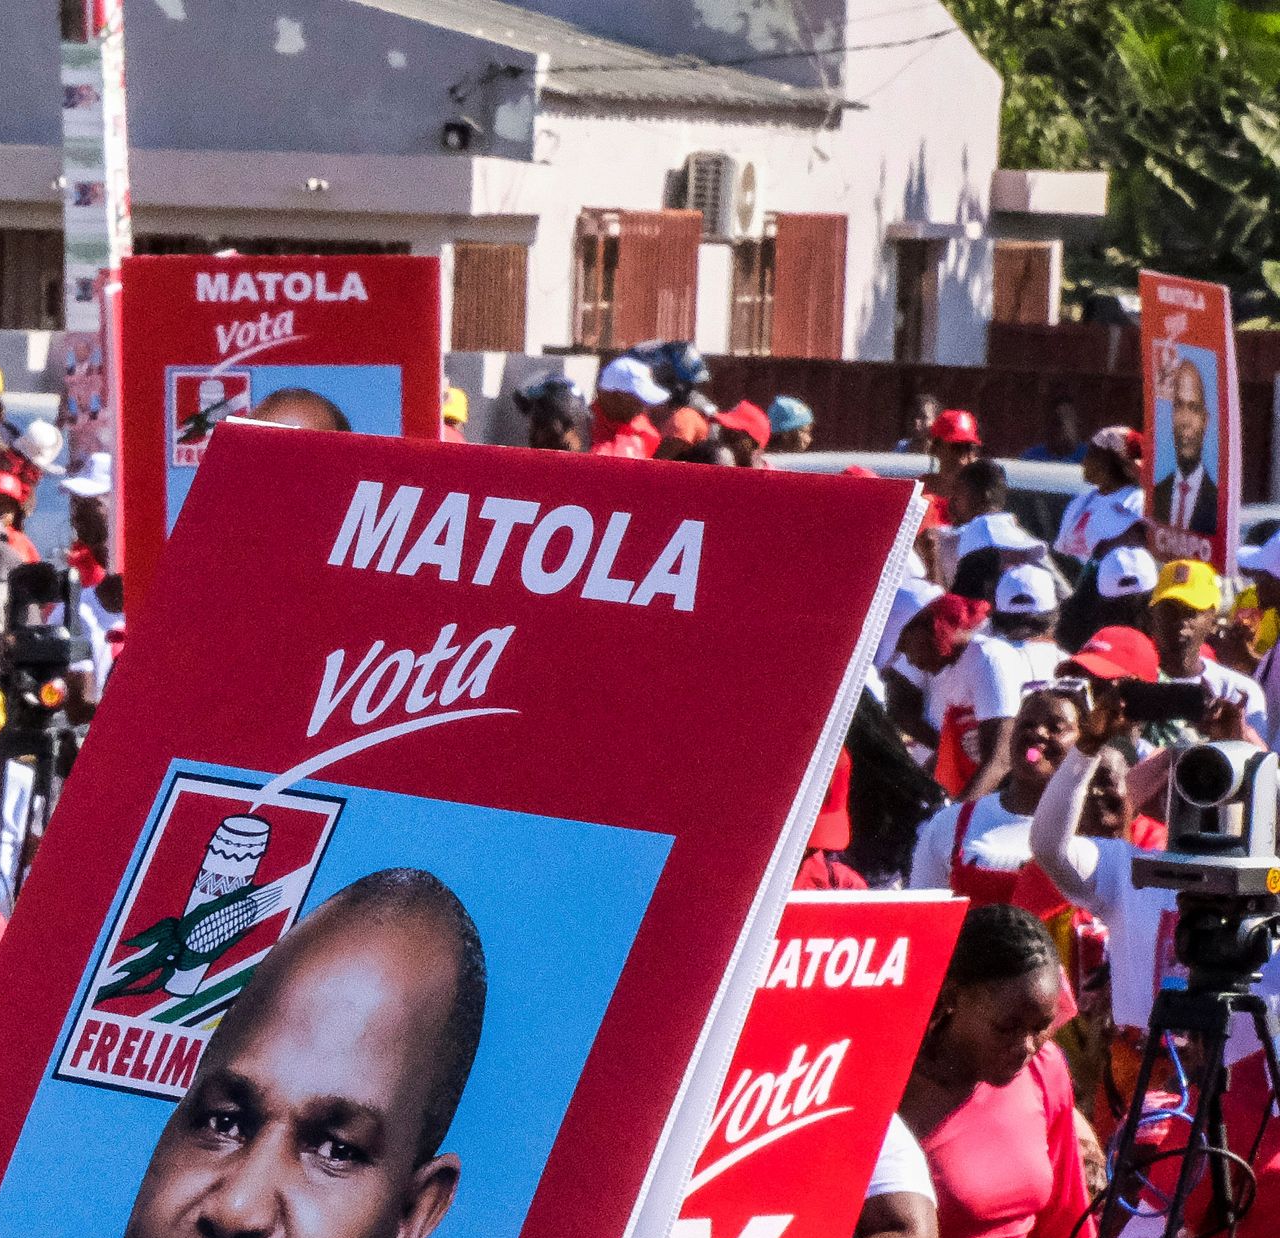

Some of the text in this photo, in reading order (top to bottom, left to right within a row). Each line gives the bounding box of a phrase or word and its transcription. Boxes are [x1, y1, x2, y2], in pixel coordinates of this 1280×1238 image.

[195, 271, 370, 303] MATOLA
[214, 309, 295, 354] Vota
[327, 480, 705, 612] MATOLA
[306, 624, 517, 738] Vota
[69, 1018, 204, 1090] FRELIM
